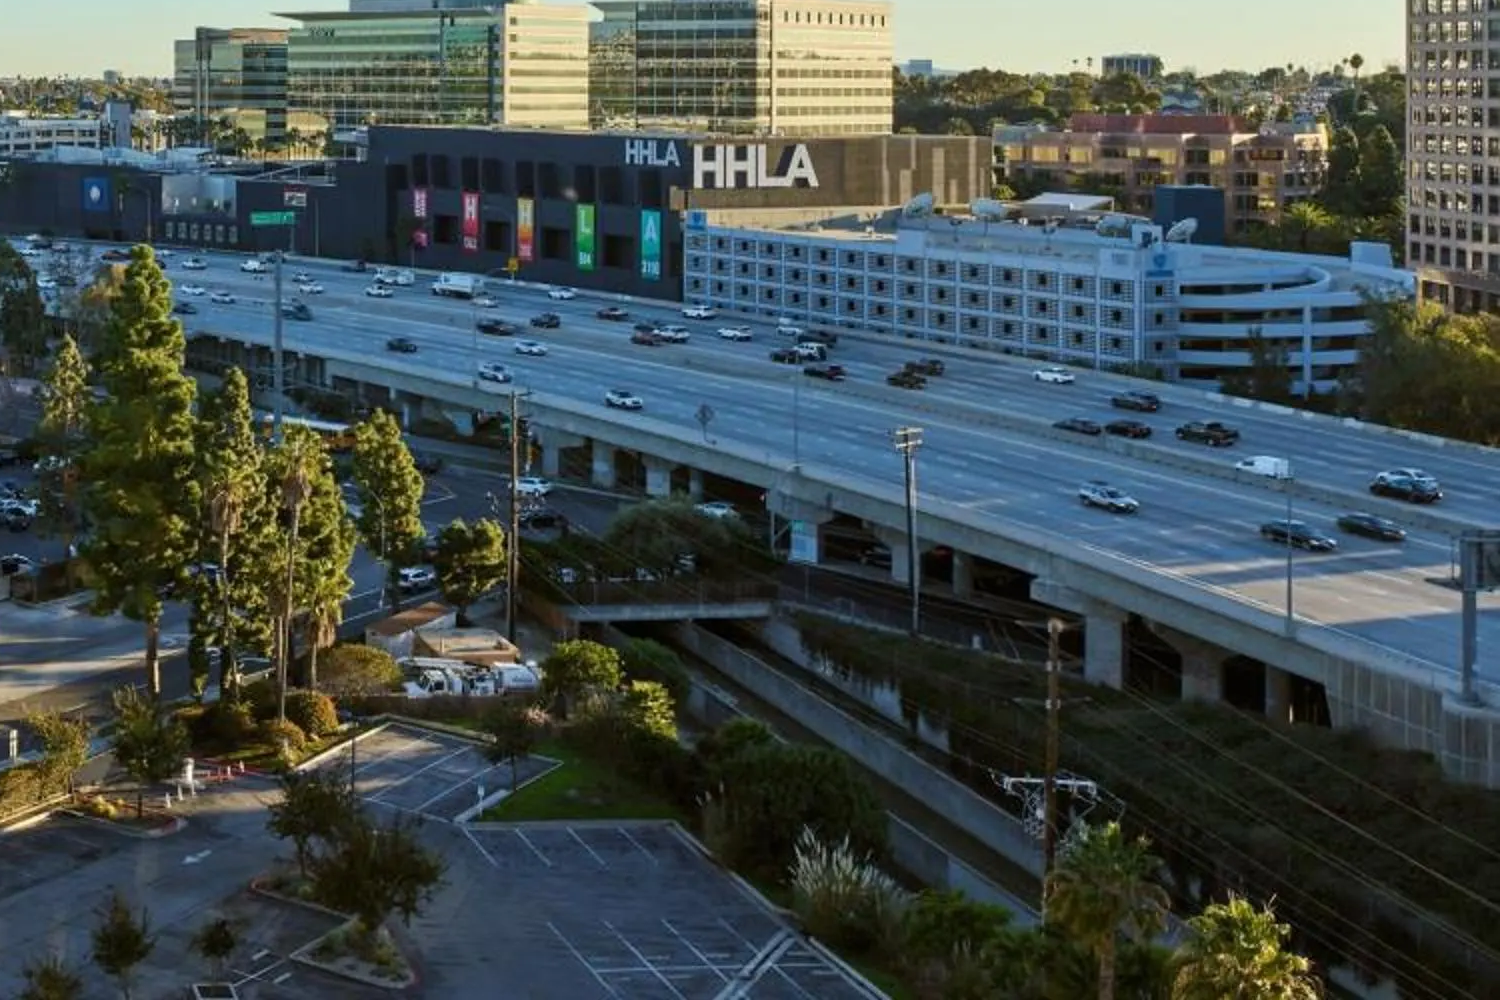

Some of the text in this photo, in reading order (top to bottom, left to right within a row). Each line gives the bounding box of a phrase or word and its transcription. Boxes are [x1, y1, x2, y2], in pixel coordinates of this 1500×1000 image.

[625, 139, 681, 167] HHLA
[693, 143, 820, 188] HHLA
[579, 209, 590, 234] L
[645, 215, 658, 240] A
